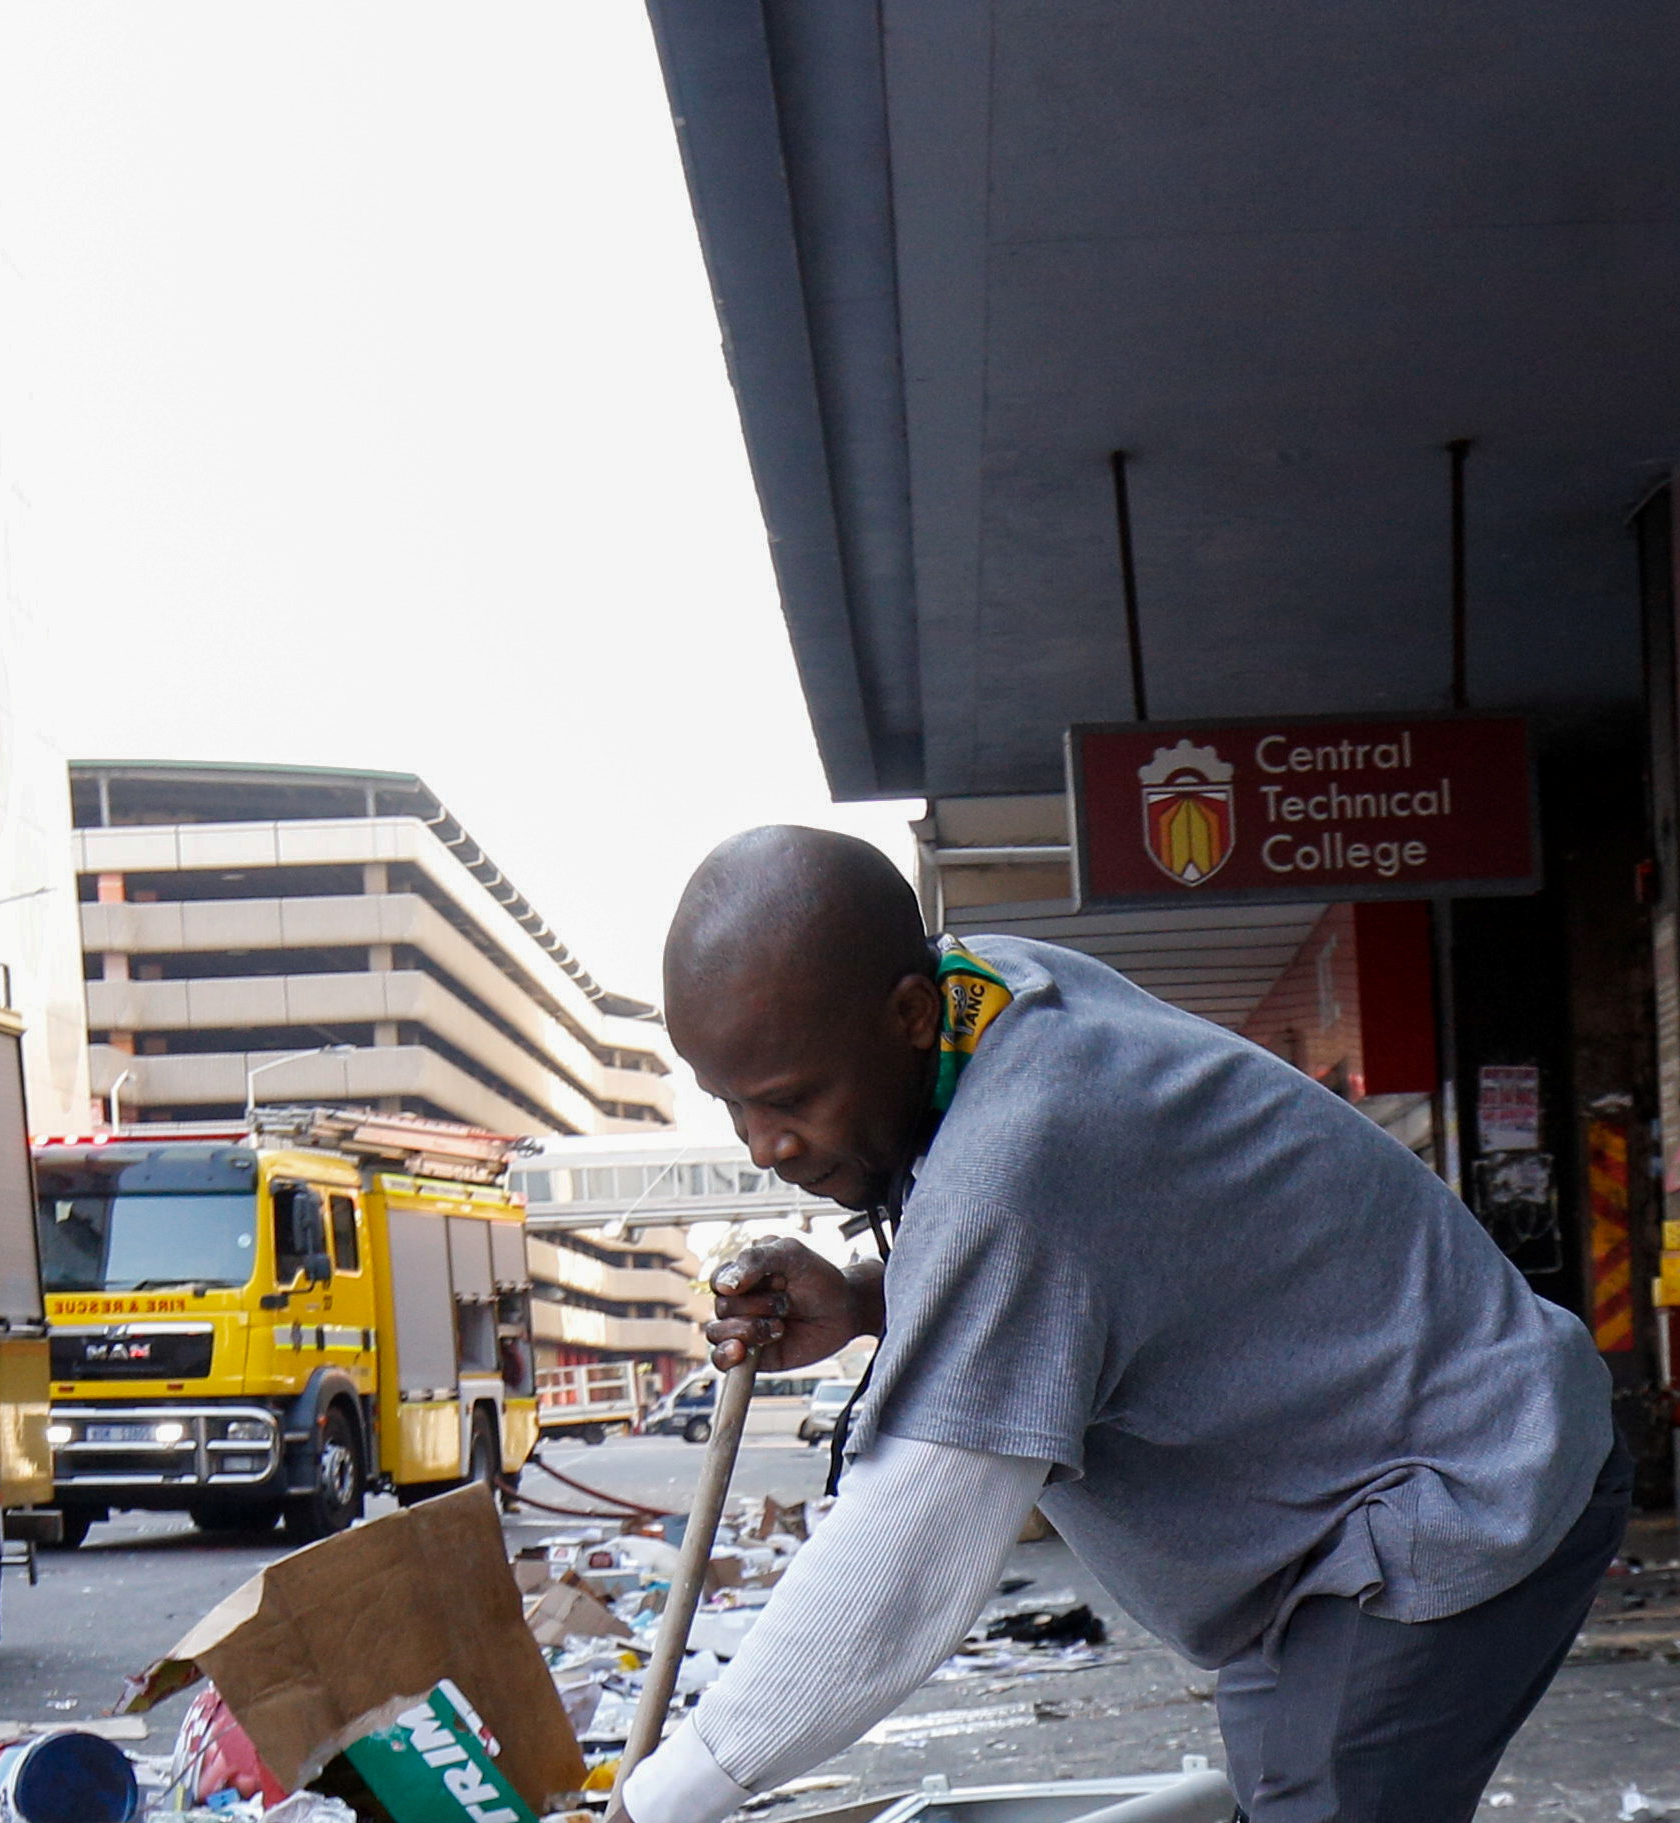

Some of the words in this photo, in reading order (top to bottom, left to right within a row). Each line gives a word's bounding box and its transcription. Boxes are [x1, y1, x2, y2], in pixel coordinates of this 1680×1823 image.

[1255, 731, 1411, 774] Central
[1259, 778, 1452, 823] Technical
[1261, 832, 1428, 877] College
[965, 983, 986, 1027] ANC
[85, 1343, 150, 1361] MAN
